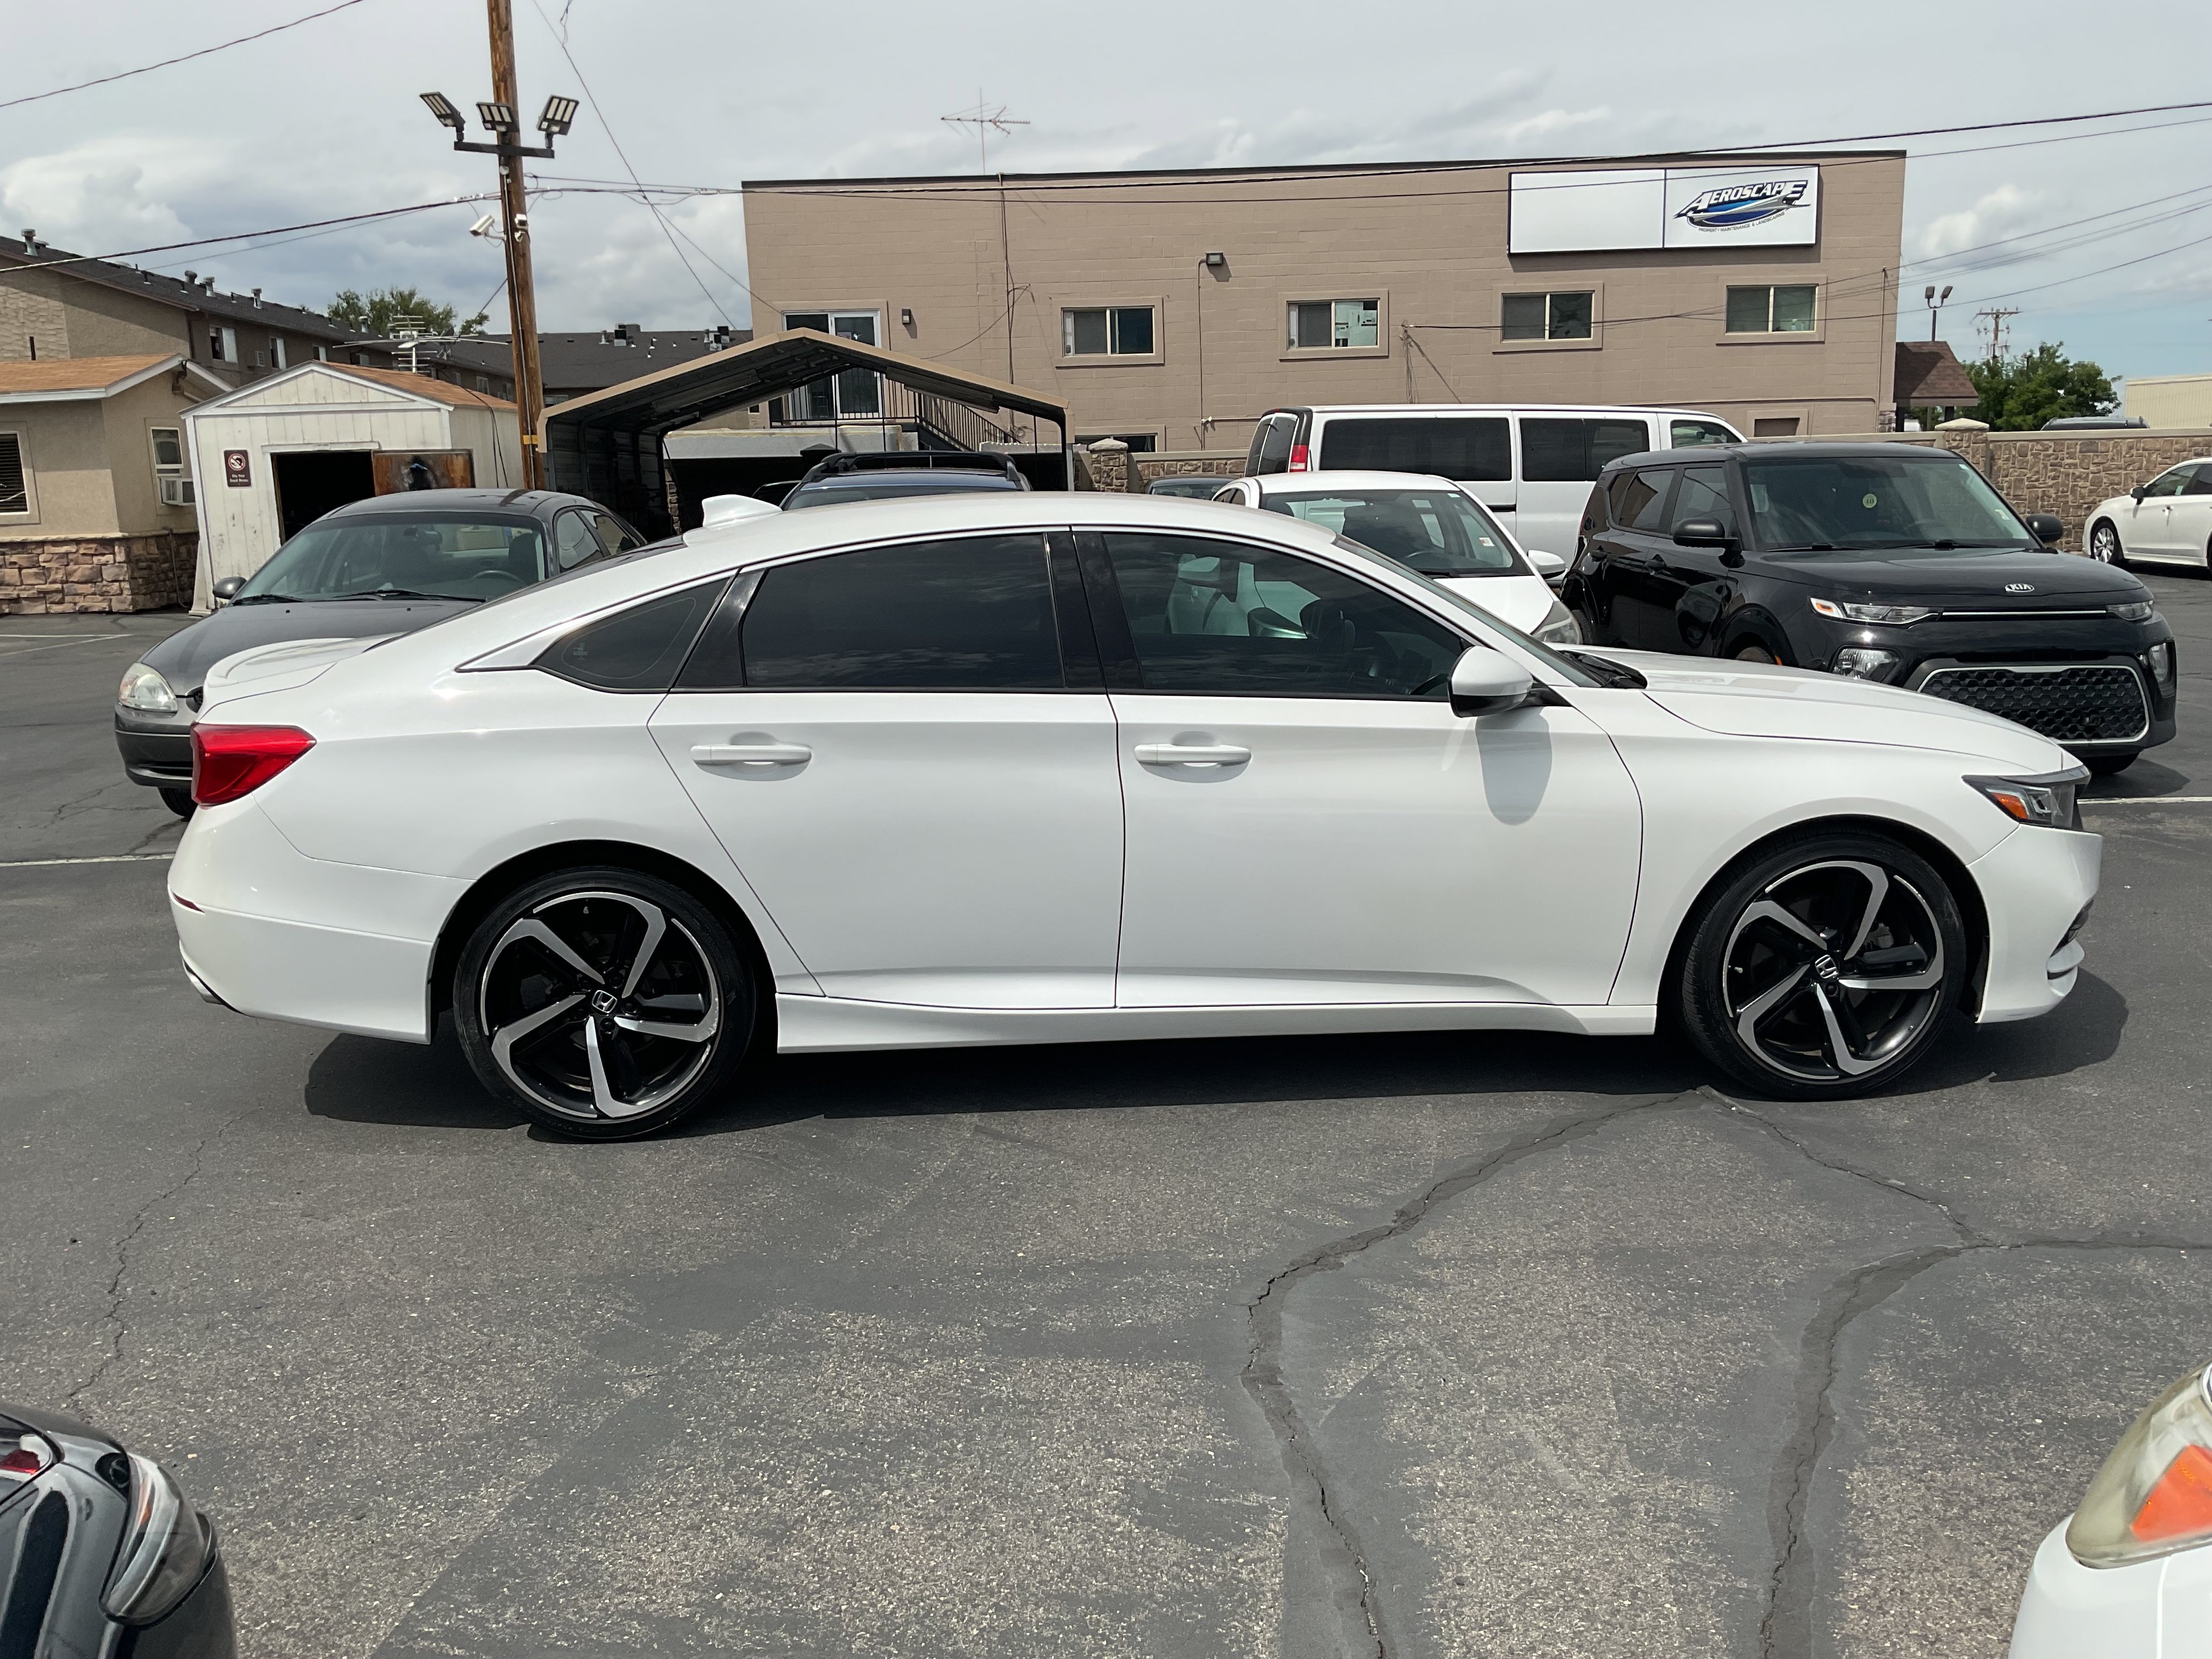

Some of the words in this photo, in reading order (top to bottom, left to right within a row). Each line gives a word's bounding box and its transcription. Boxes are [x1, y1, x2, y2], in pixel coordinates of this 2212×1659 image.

[1673, 180, 1808, 218] AEROSCAPE
[1720, 223, 1751, 232] MAINTENANCE
[1756, 211, 1785, 225] LANDSCAPING
